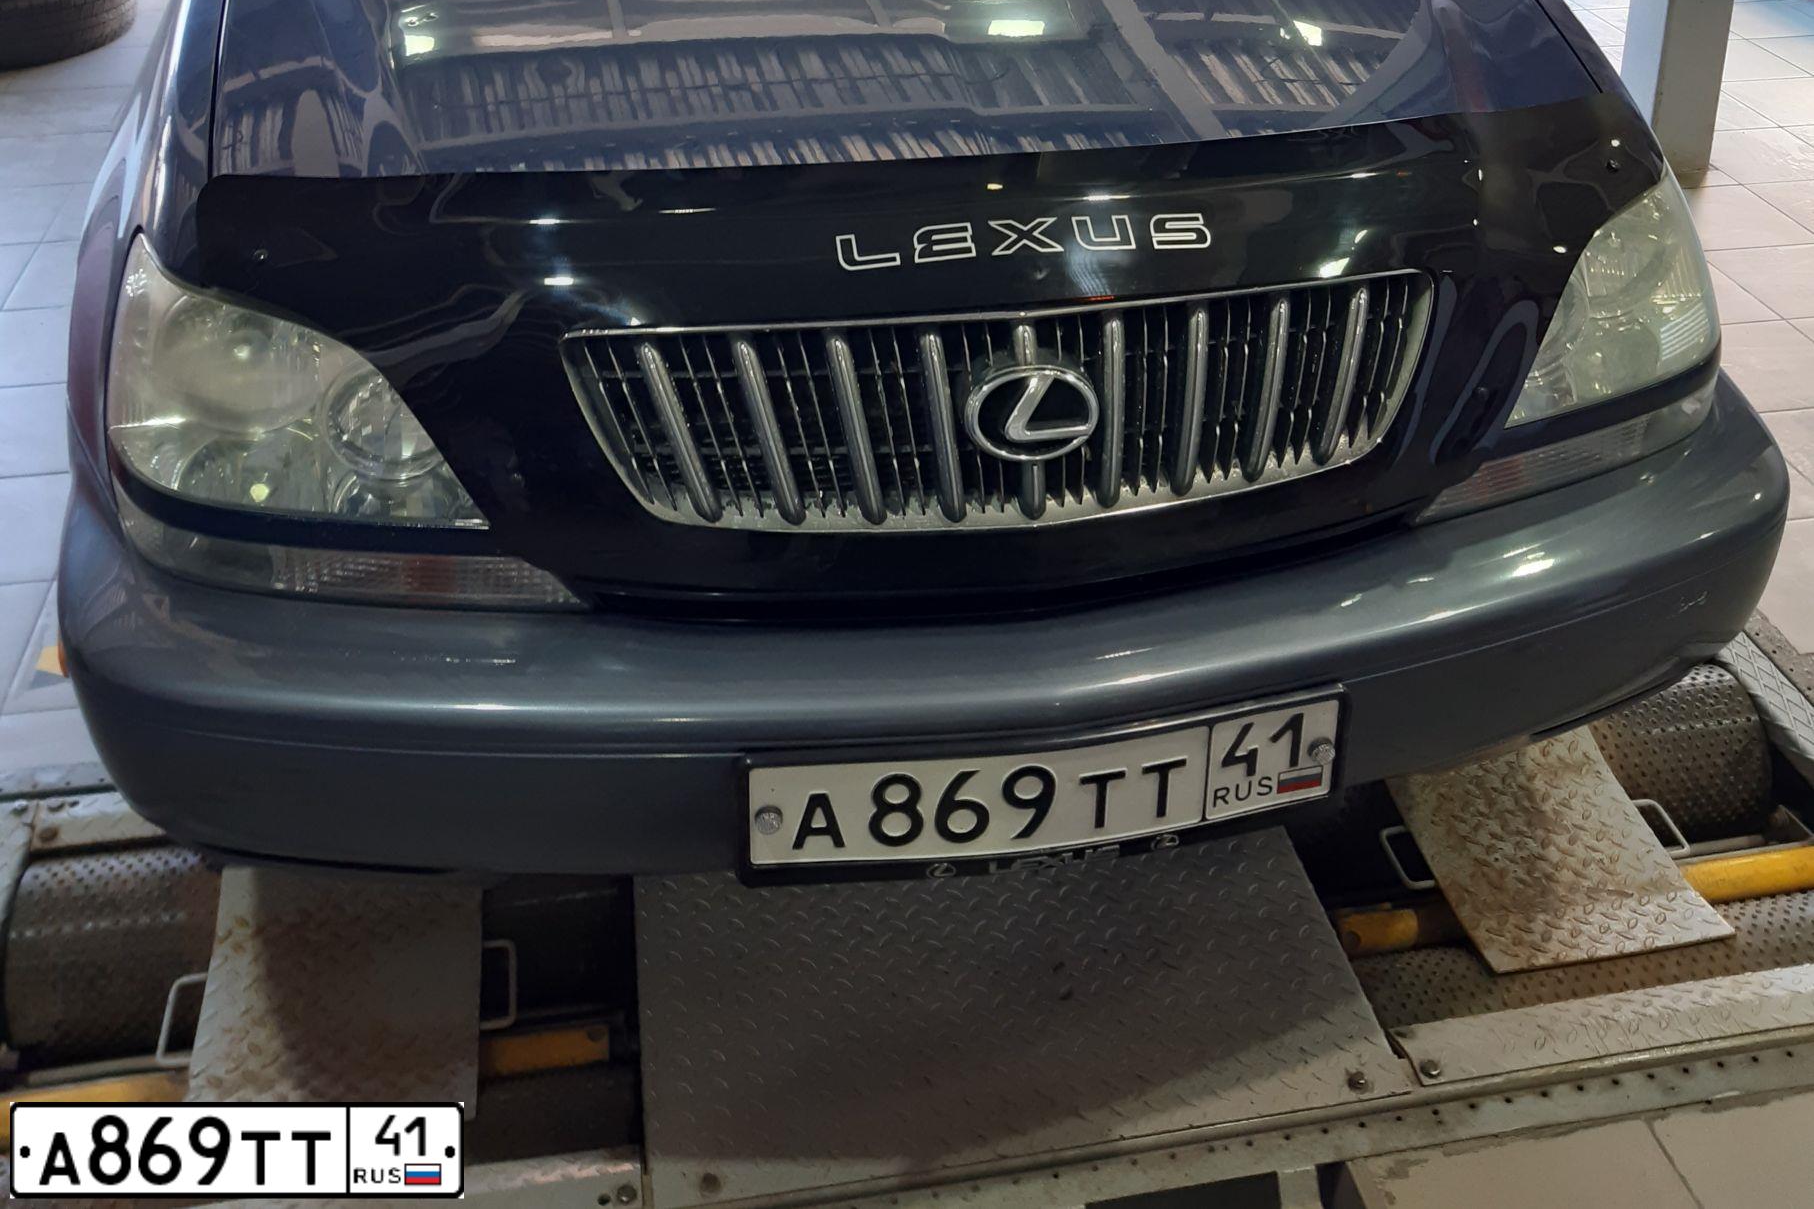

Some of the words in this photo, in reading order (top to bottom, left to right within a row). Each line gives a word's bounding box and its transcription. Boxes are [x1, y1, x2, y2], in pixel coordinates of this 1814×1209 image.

[835, 213, 1211, 271] LEXUS
[1220, 712, 1304, 777] 41
[1212, 775, 1273, 808] RUS
